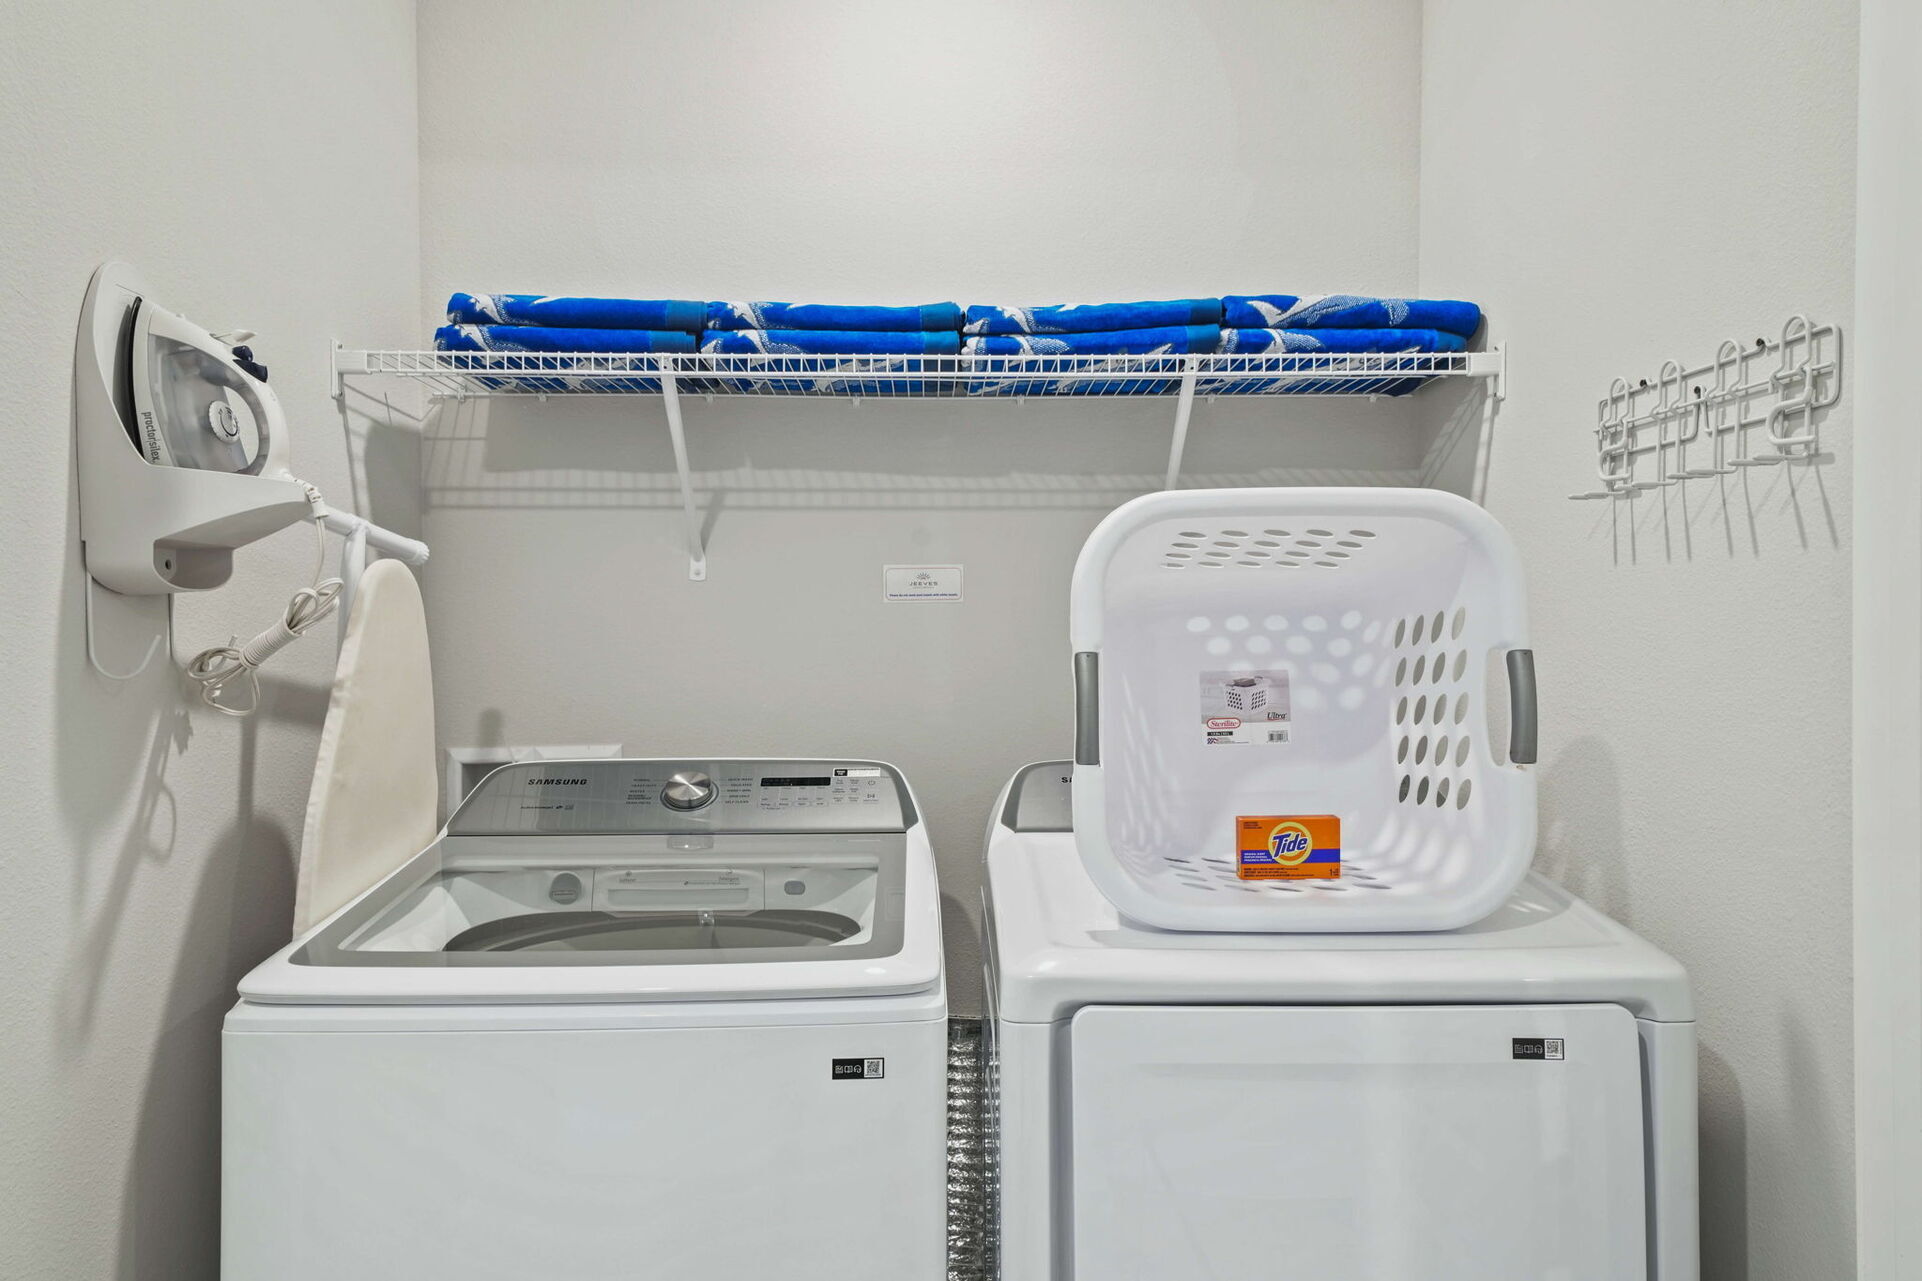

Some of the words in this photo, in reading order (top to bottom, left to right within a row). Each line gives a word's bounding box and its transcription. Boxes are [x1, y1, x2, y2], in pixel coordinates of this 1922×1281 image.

[1267, 711, 1286, 720] Ultra
[527, 778, 588, 786] SAMSUNG
[1272, 832, 1308, 858] Tide
